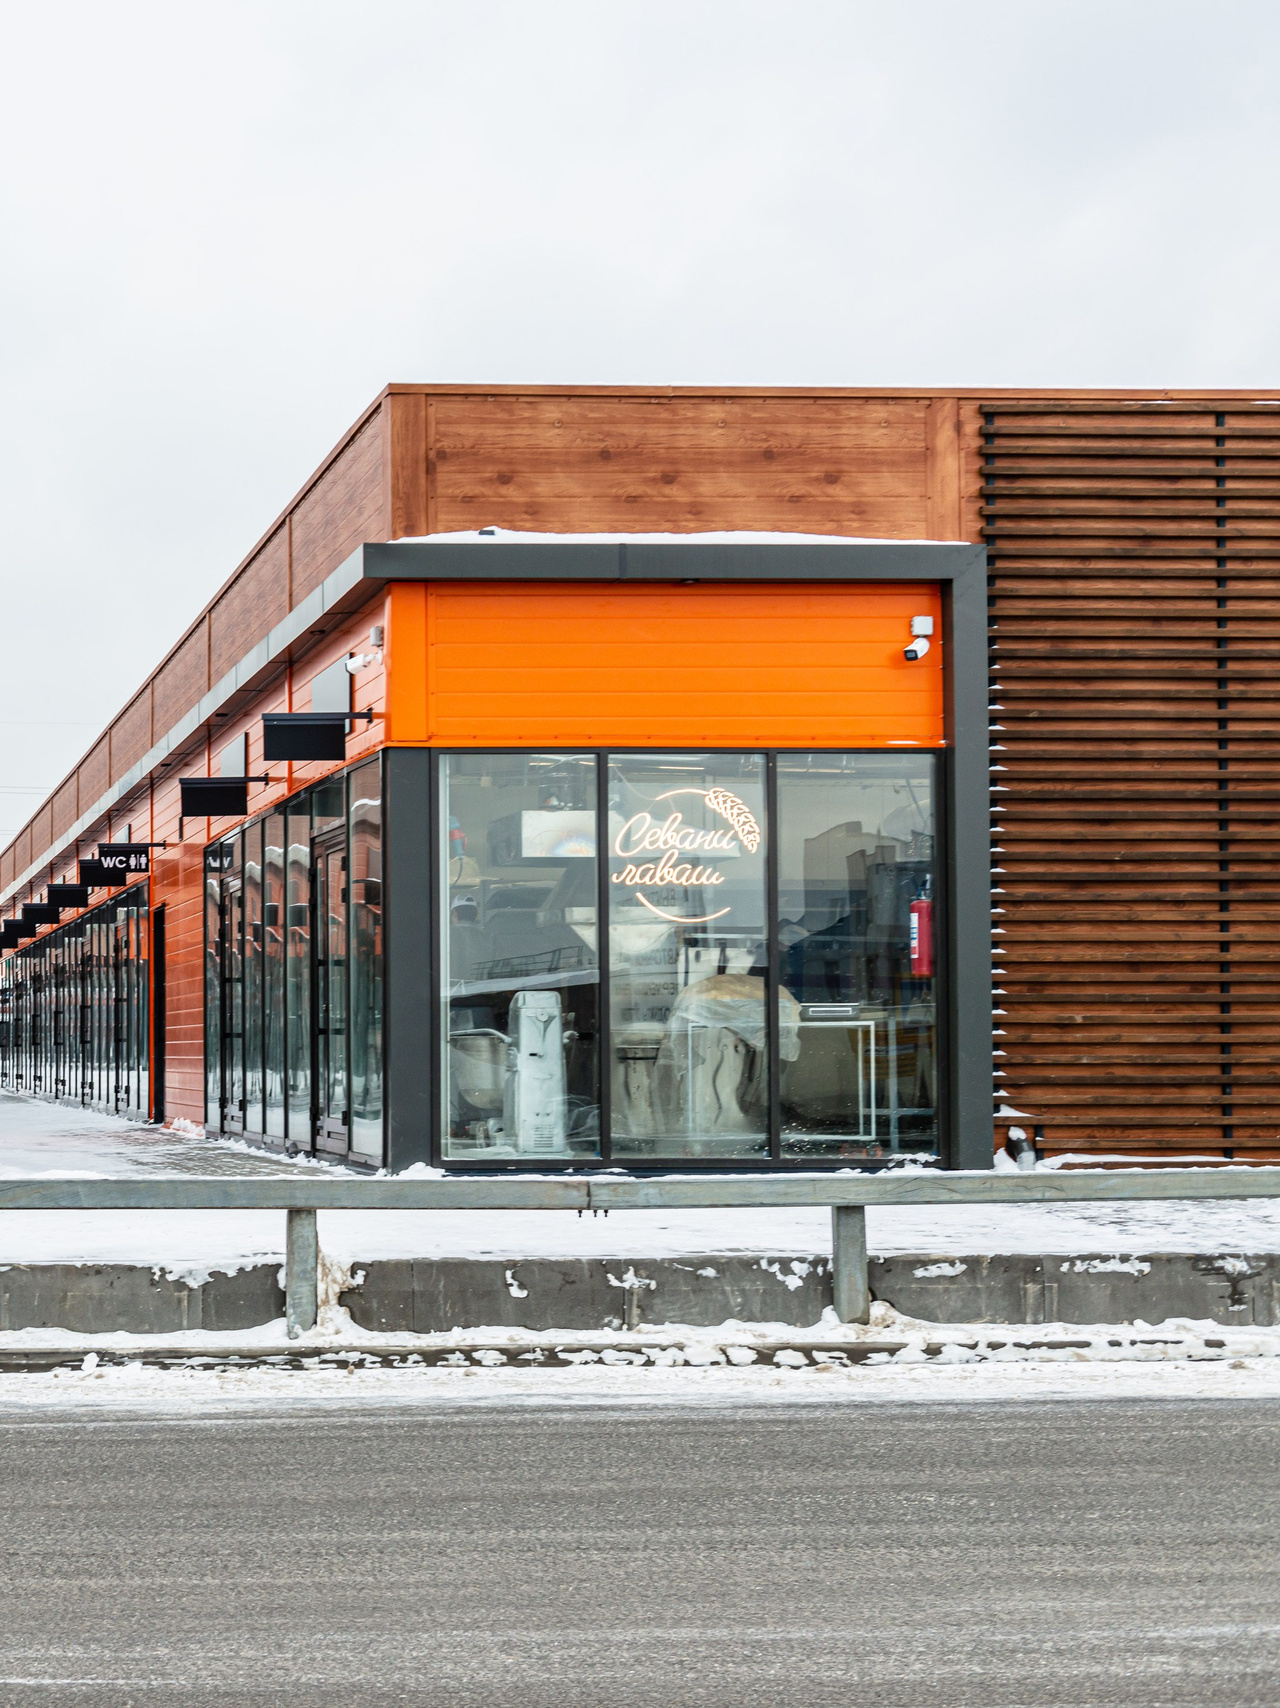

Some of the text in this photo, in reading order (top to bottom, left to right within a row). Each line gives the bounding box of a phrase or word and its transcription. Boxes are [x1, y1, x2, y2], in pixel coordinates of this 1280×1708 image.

[615, 811, 737, 856] Севани
[100, 856, 127, 869] WC
[611, 848, 726, 886] лаваш
